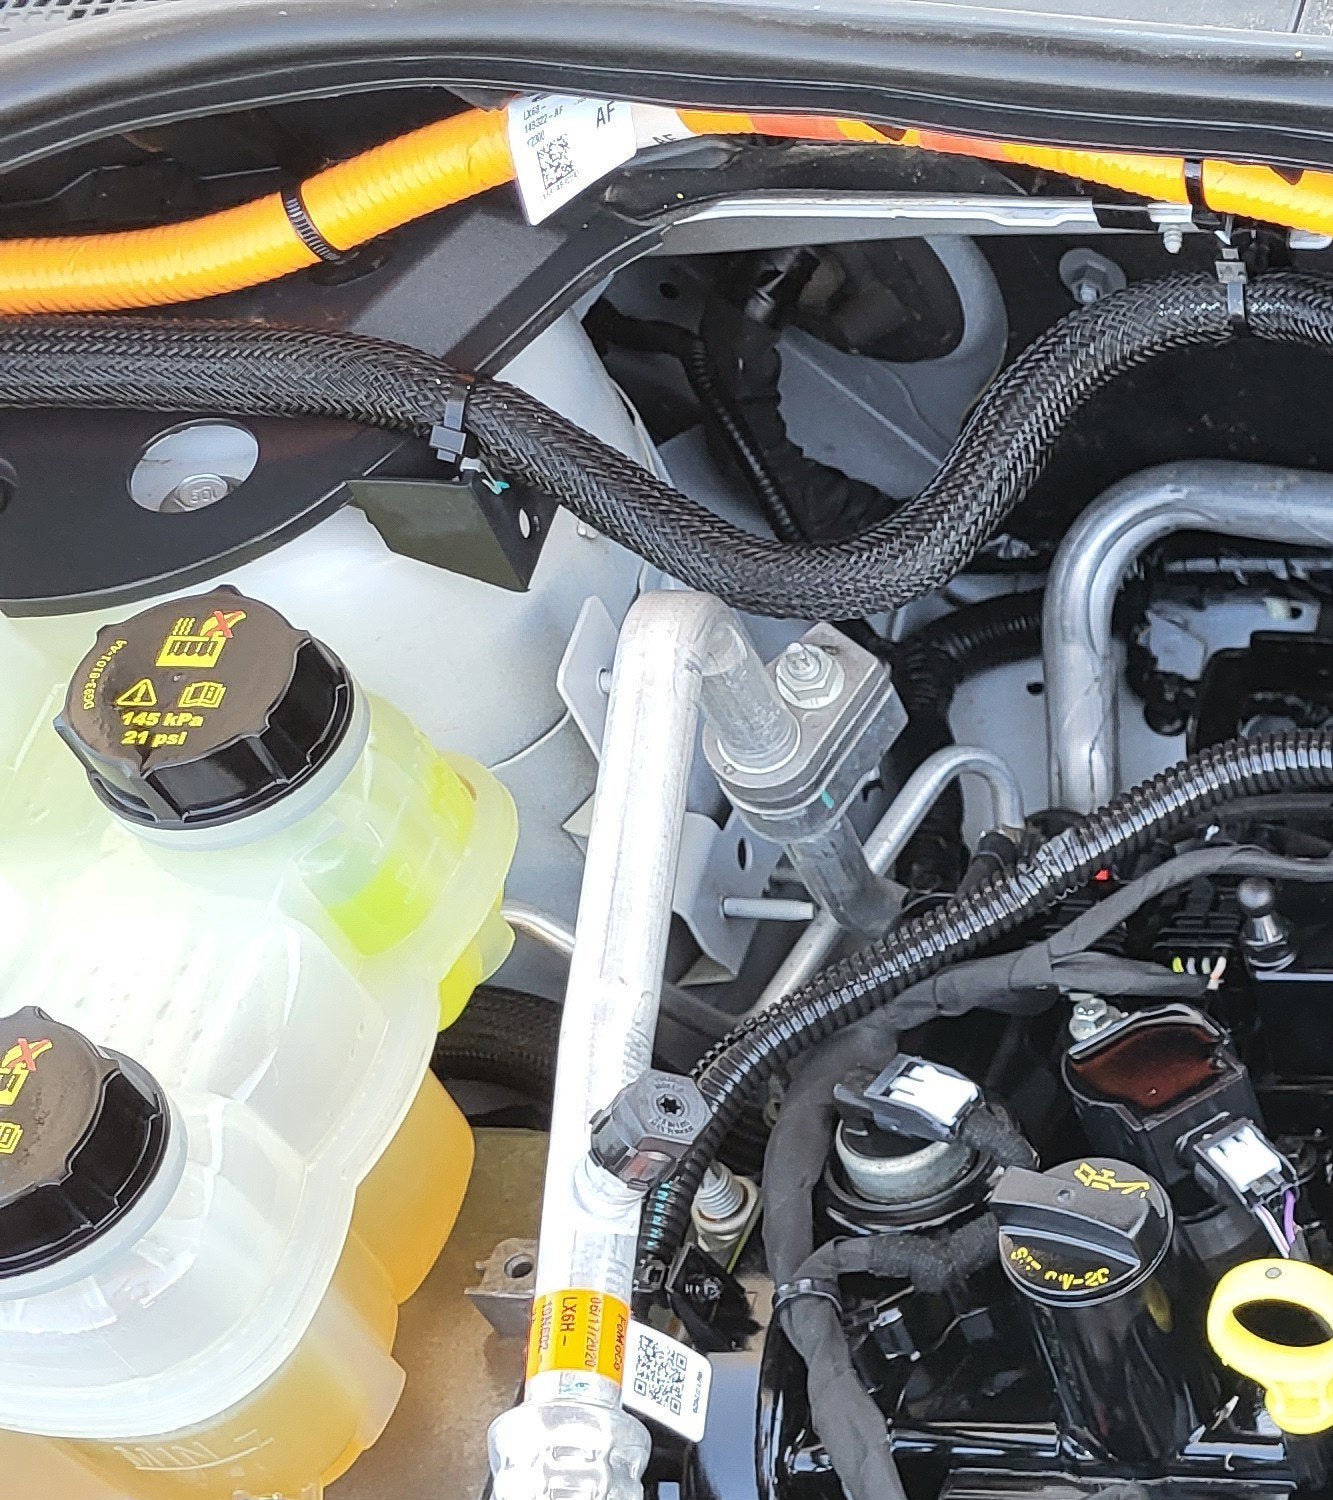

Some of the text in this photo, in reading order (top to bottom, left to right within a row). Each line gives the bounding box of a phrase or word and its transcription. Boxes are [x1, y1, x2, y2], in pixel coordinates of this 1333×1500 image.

[596, 101, 615, 128] AF
[121, 711, 204, 727] 145 kPa
[121, 730, 188, 748] 21 psi
[114, 1441, 219, 1466] MIN
